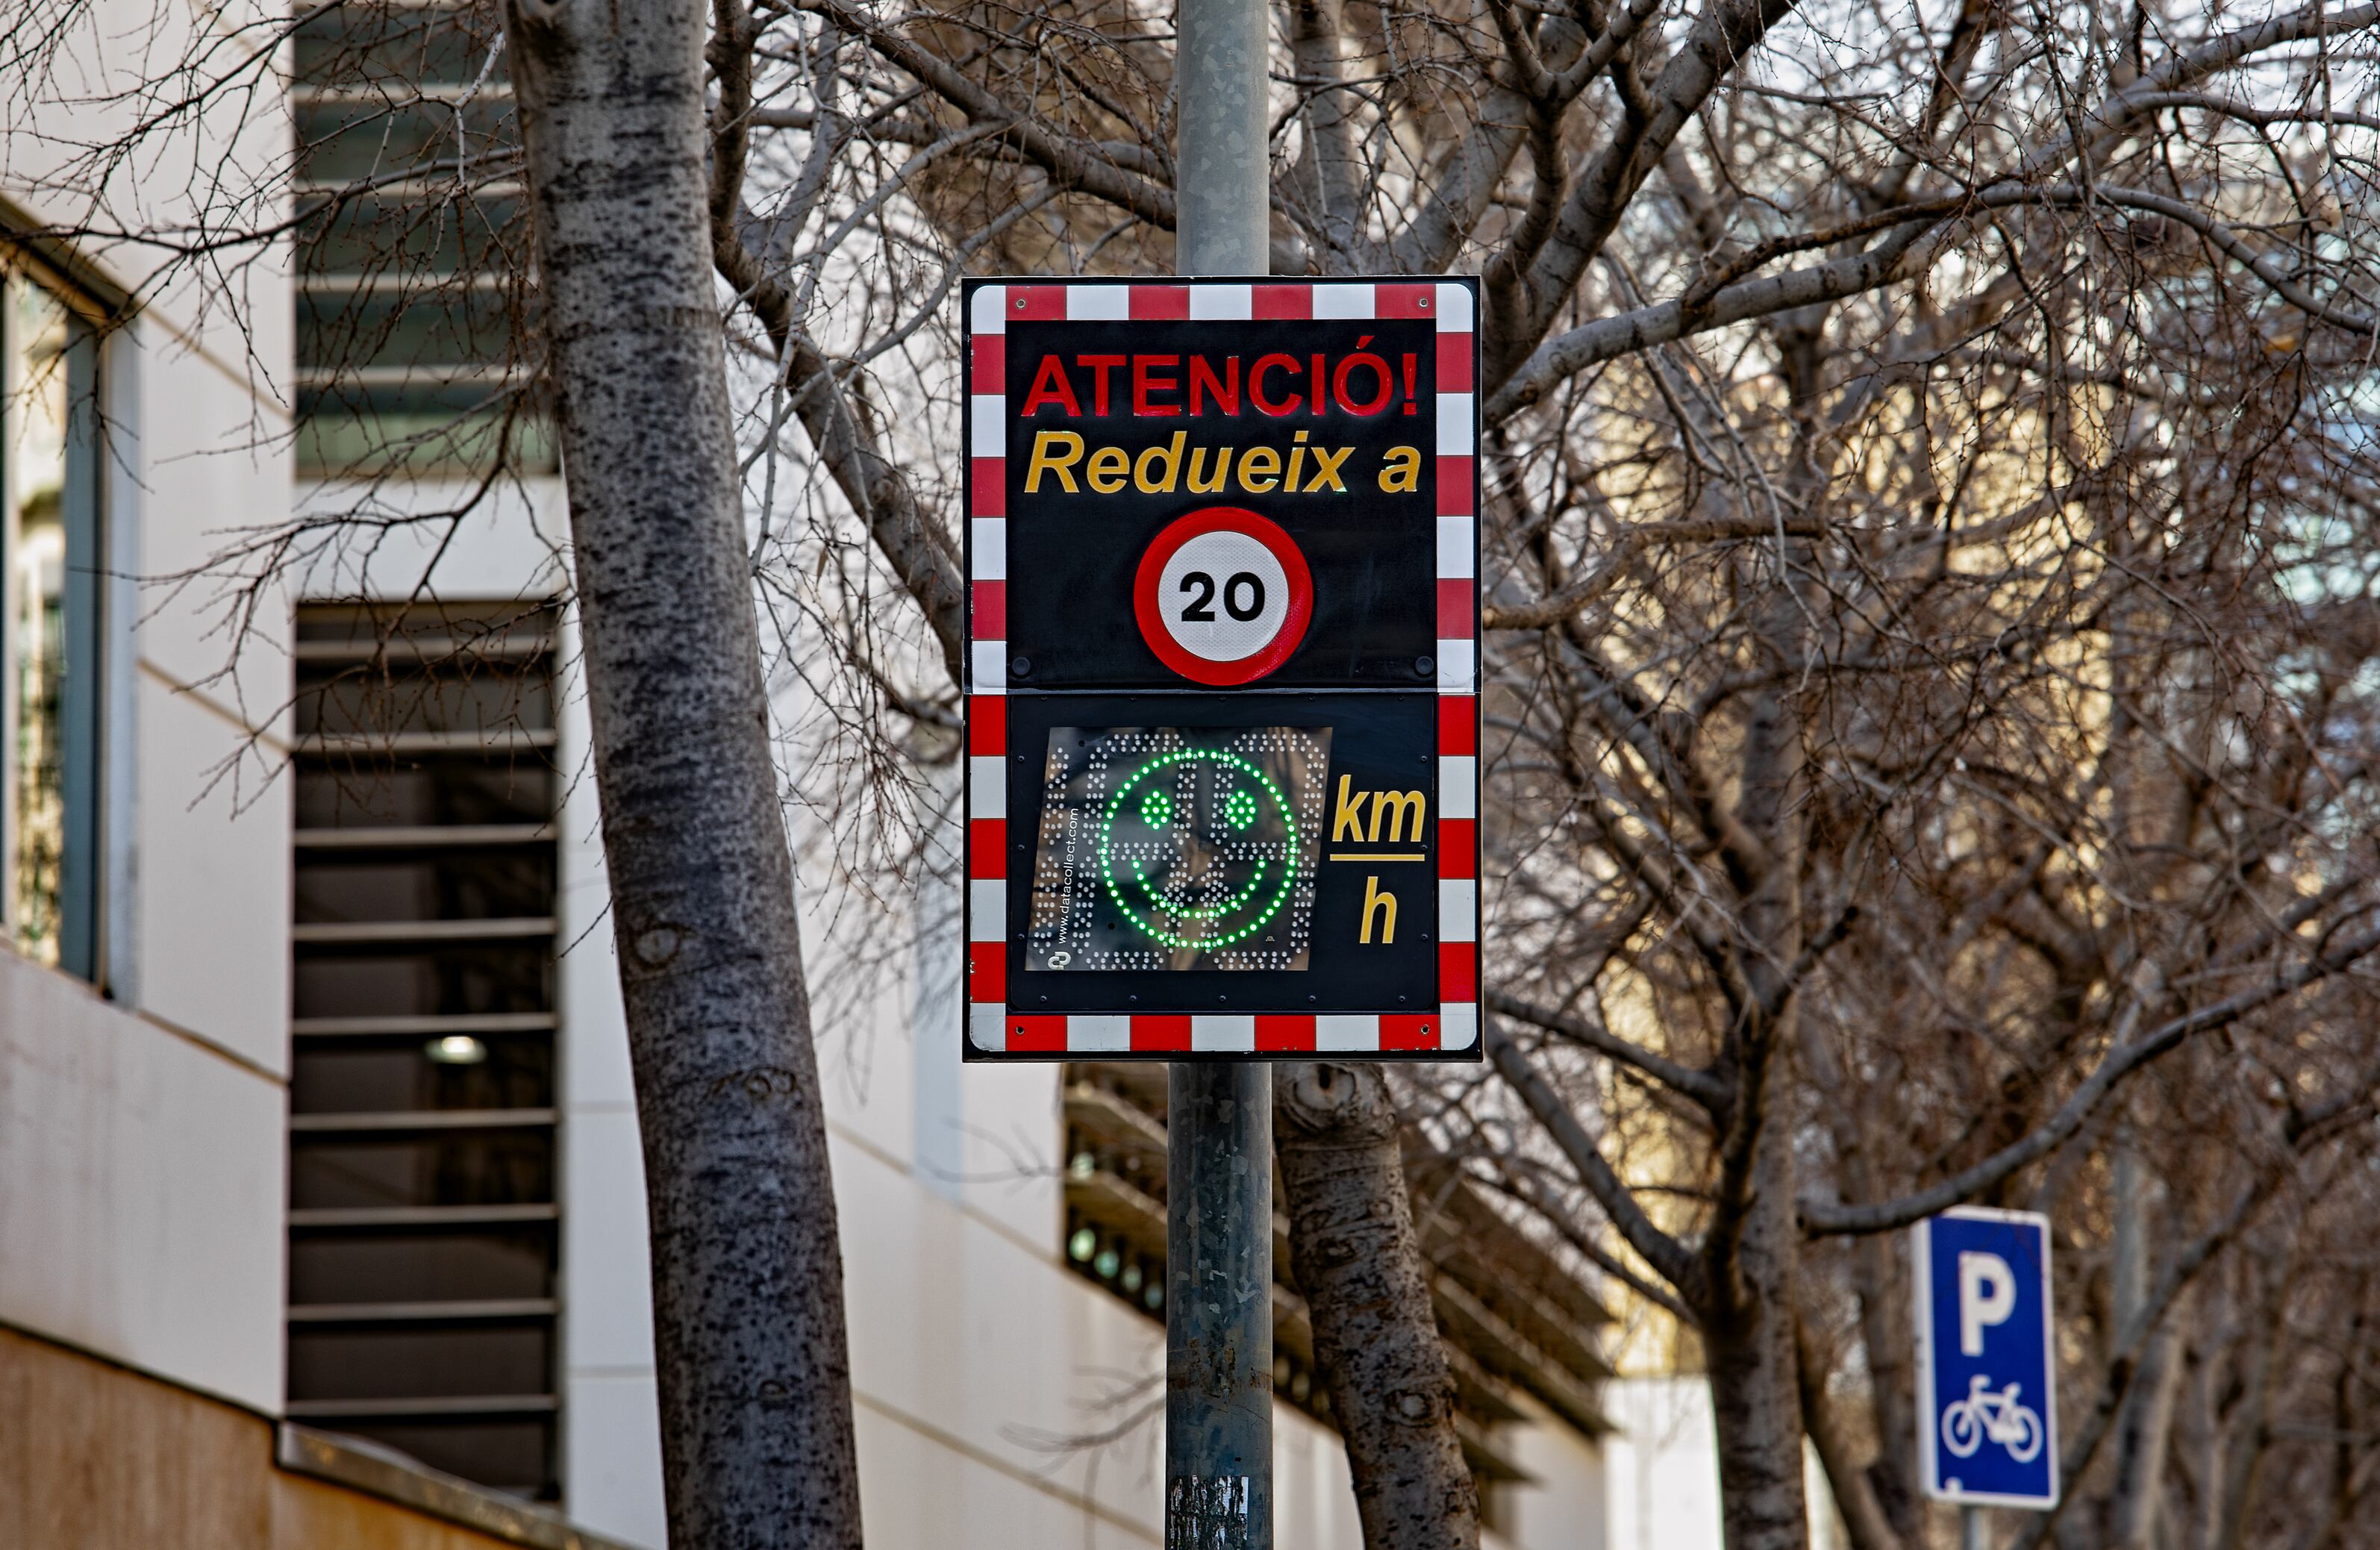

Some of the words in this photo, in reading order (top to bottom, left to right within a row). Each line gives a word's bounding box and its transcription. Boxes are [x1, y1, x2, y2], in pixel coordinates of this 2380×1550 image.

[1021, 335, 1417, 416] ATENCIÓ!
[1025, 431, 1355, 493] Redueix
[1378, 446, 1421, 493] a
[1179, 571, 1266, 622] 20
[1331, 774, 1426, 842] km
[1058, 808, 1079, 944] www.datacollect.com
[1359, 876, 1397, 943] h
[1958, 1251, 2017, 1356] P
